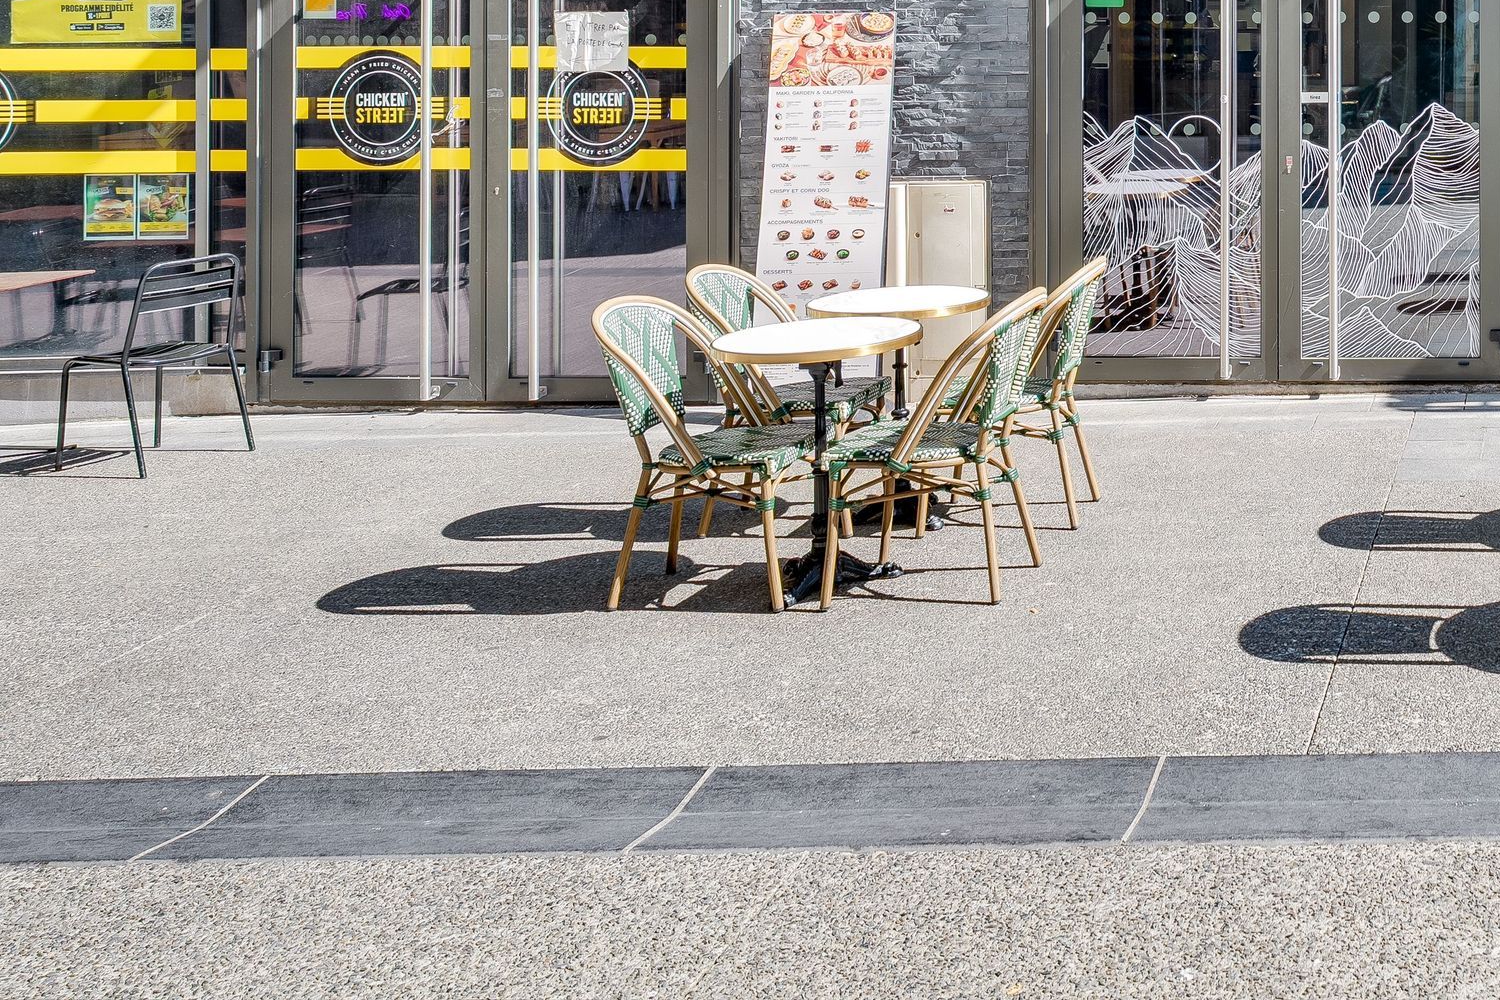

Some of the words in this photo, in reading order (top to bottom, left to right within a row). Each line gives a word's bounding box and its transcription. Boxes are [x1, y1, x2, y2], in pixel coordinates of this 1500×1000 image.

[60, 4, 104, 12] PROGRAMME
[106, 3, 134, 12] FIDÉLITÉ
[392, 64, 419, 86] CHICKEN
[356, 93, 405, 107] CHICKEN
[573, 92, 622, 107] CHICKEN
[356, 108, 405, 124] STREET
[573, 108, 622, 124] STREET
[345, 135, 352, 143] LA
[354, 143, 377, 155] STREET
[381, 147, 400, 155] C'EST
[402, 135, 417, 148] CHIC
[571, 143, 594, 155] STREET
[597, 147, 617, 155] C'EST
[618, 135, 634, 149] CHIC
